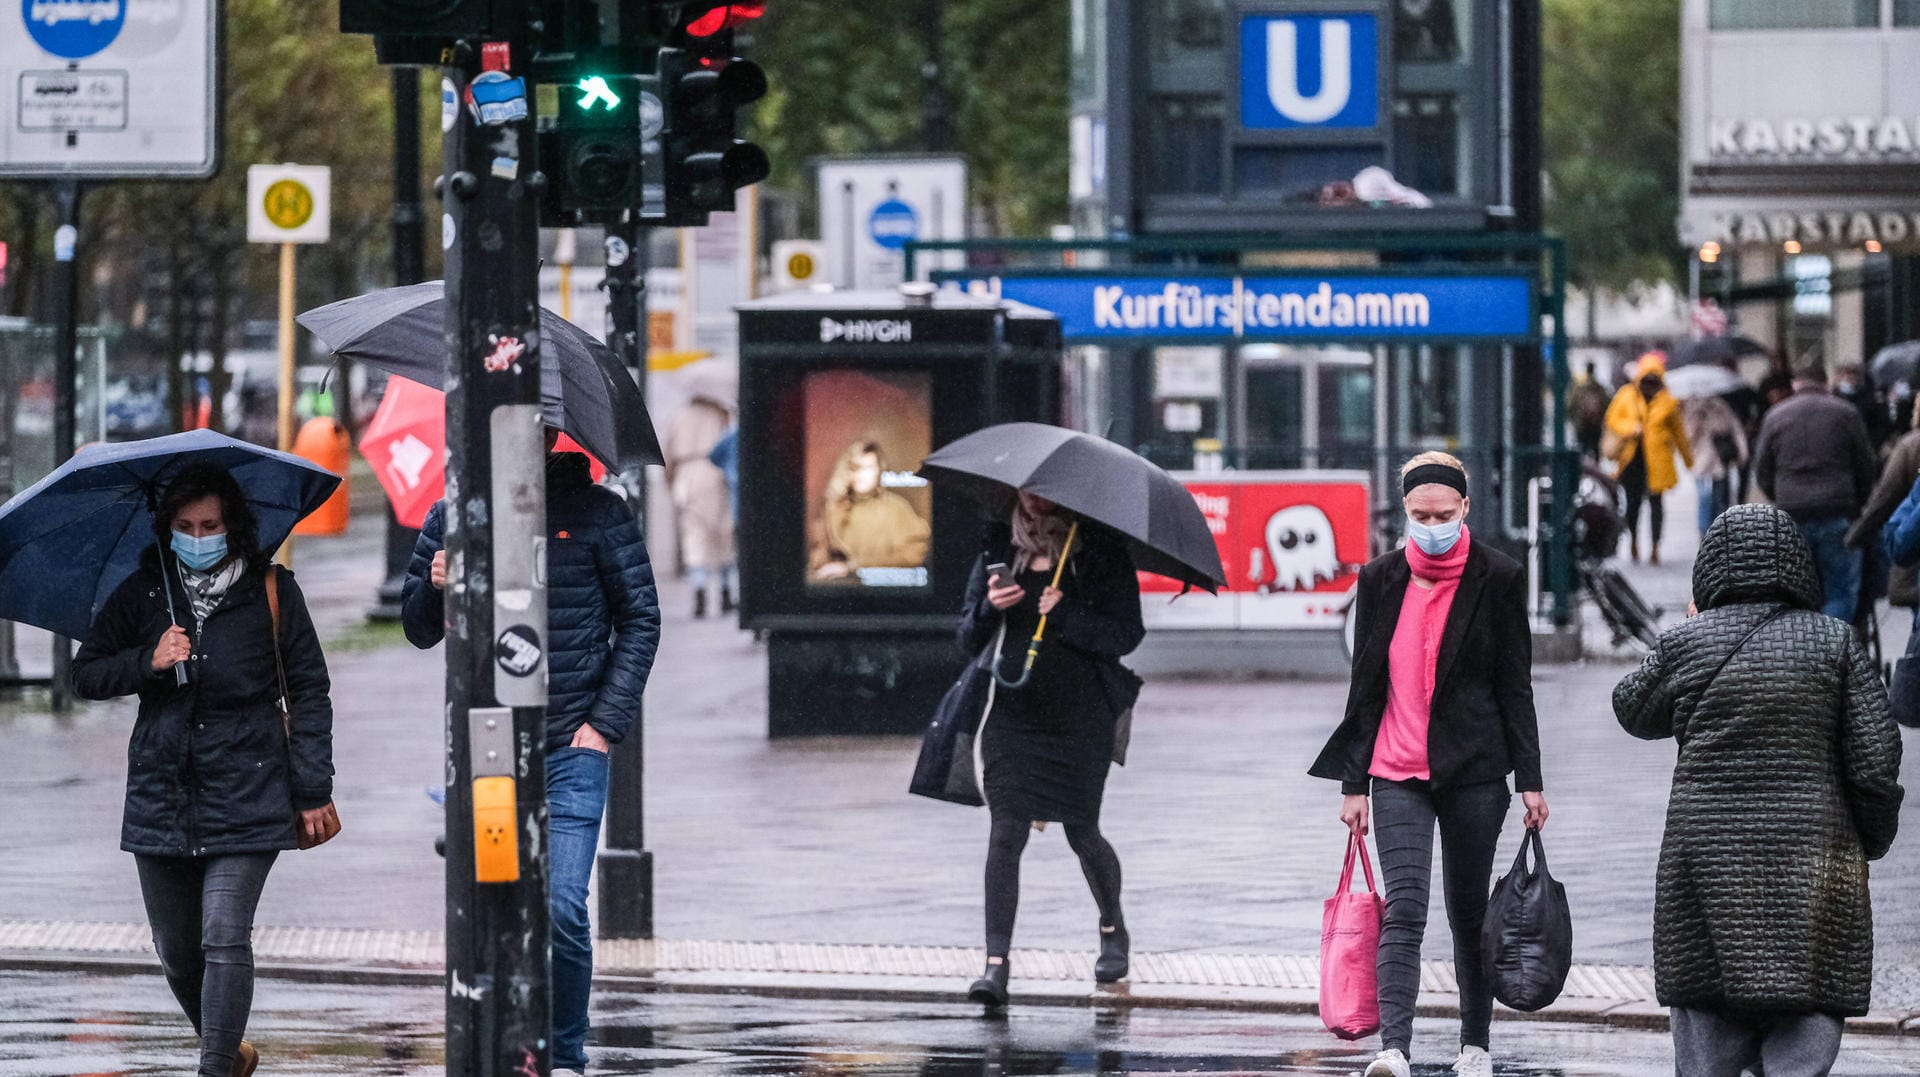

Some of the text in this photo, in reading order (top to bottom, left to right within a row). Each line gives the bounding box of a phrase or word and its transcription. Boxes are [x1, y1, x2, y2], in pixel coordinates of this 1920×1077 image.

[1266, 19, 1350, 123] U
[1711, 116, 1920, 151] KARSTA
[1712, 210, 1920, 242] KARSTAD
[1094, 282, 1429, 328] Kurfürstendamm
